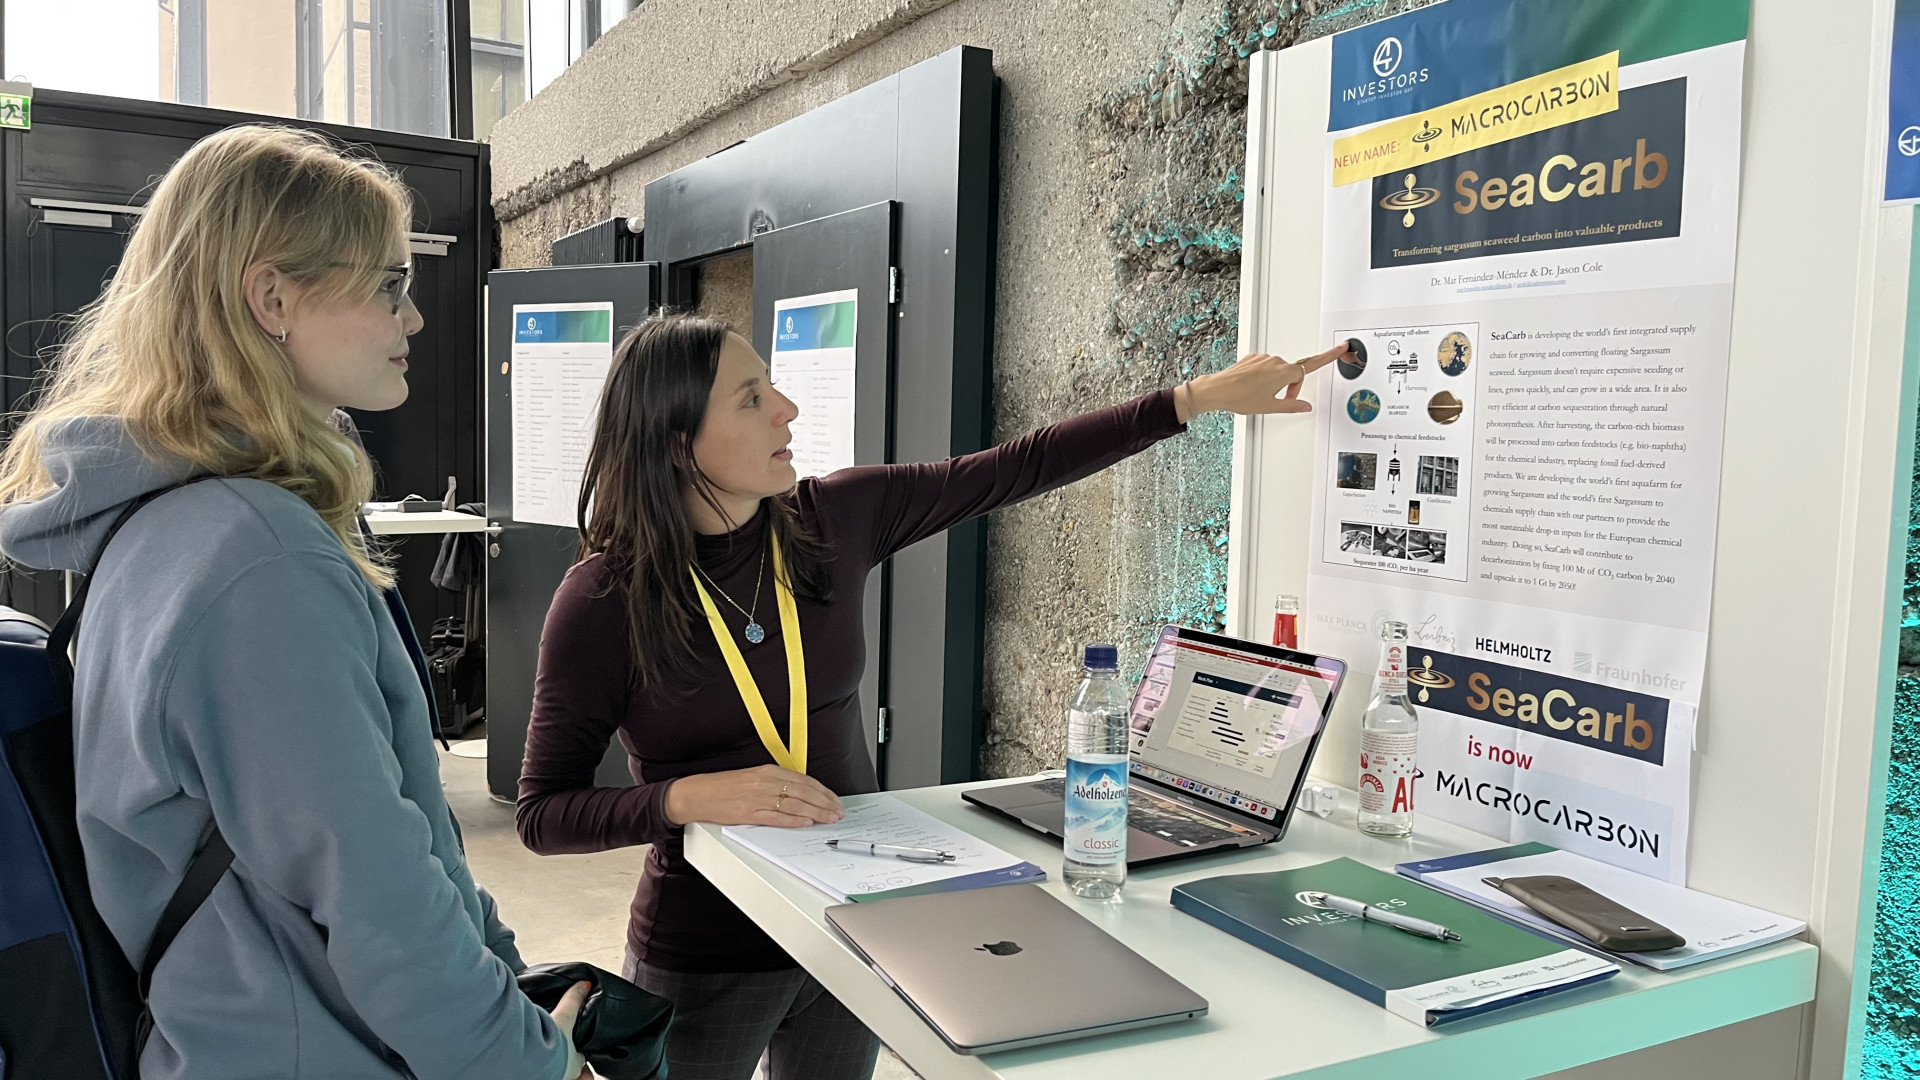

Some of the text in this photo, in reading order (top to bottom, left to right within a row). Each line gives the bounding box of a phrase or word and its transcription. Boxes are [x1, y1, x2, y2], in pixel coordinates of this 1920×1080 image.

[1343, 68, 1429, 103] INVESTORS
[1357, 86, 1414, 106] STARTUP INVESTOR DAY
[1451, 71, 1610, 138] MACROCARBON
[1334, 141, 1400, 169] NEW NAME:
[1453, 138, 1669, 216] SeaCarb
[1392, 218, 1663, 259] Transforming sargassum seaweed carbon into valuable products
[1430, 276, 1442, 287] Dr.
[1444, 276, 1456, 286] Mar
[1530, 268, 1538, 278] &
[1540, 266, 1554, 276] Dr.
[1556, 264, 1580, 277] Jason
[1582, 262, 1604, 272] Cole
[1491, 330, 1526, 340] SeaCarb
[1534, 330, 1571, 340] developing
[1613, 327, 1627, 335] first
[1629, 324, 1668, 336] integrated
[1670, 324, 1696, 335] supply
[1519, 352, 1546, 360] growing
[1548, 349, 1560, 357] and
[1562, 350, 1599, 358] converting
[1601, 347, 1628, 357] floating
[1630, 346, 1670, 357] Sargassum
[1517, 367, 1552, 378] Sargassum
[1580, 368, 1604, 377] require
[1606, 368, 1642, 376] expensive
[1643, 364, 1673, 375] seeding
[1505, 387, 1524, 395] grows
[1526, 385, 1551, 396] quickly,
[1580, 387, 1598, 395] grow
[1615, 384, 1632, 392] wide
[1671, 384, 1687, 392] also
[1487, 402, 1668, 414] very efficient carbon sequestration through natural
[1537, 420, 1554, 428] After
[1556, 420, 1593, 431] harvesting,
[1607, 421, 1650, 430] carbon-rich
[1652, 422, 1684, 431] biomass
[1507, 438, 1540, 447] processed
[1556, 438, 1580, 447] carbon
[1581, 439, 1618, 448] feedstocks
[1636, 440, 1686, 452] bio-naphtha)
[1508, 454, 1666, 469] chemical industry, replacing fossil fuel-derived
[1538, 473, 1574, 485] developing
[1615, 477, 1630, 486] first
[1632, 479, 1668, 489] aquafarm
[1483, 489, 1510, 498] growing
[1511, 488, 1544, 499] Sargassum
[1546, 491, 1558, 499] and
[1598, 494, 1612, 503] first
[1613, 495, 1653, 507] Sargassum
[1482, 504, 1513, 513] chemicals
[1515, 507, 1536, 518] supply
[1537, 508, 1554, 517] chain
[1556, 510, 1570, 518] with
[1585, 514, 1614, 522] partners
[1626, 516, 1655, 526] provide
[1657, 518, 1670, 526] the
[1500, 523, 1534, 532] sustainable
[1535, 525, 1560, 536] drop-in
[1561, 530, 1582, 539] inputs
[1609, 532, 1646, 544] European
[1648, 536, 1682, 547] chemical
[1512, 540, 1532, 552] Doing
[1544, 544, 1571, 554] SeaCarb
[1572, 547, 1584, 556] will
[1586, 550, 1622, 560] contribute
[1493, 574, 1516, 583] upscale
[1562, 563, 1574, 572] 100
[1616, 571, 1642, 580] carbon
[1656, 574, 1675, 584] 2040
[1316, 613, 1334, 624] MAX
[1336, 617, 1368, 631] PLANCK
[1414, 614, 1456, 652] Leibniz
[1475, 636, 1552, 664] HELMHOLTZ
[1595, 661, 1687, 693] Fraunhofer
[1466, 672, 1654, 750] SeaCarb
[1467, 735, 1533, 770] is now
[1436, 770, 1660, 858] MACROCARBON
[1084, 838, 1119, 849] classic
[1281, 898, 1408, 926] INVESRS
